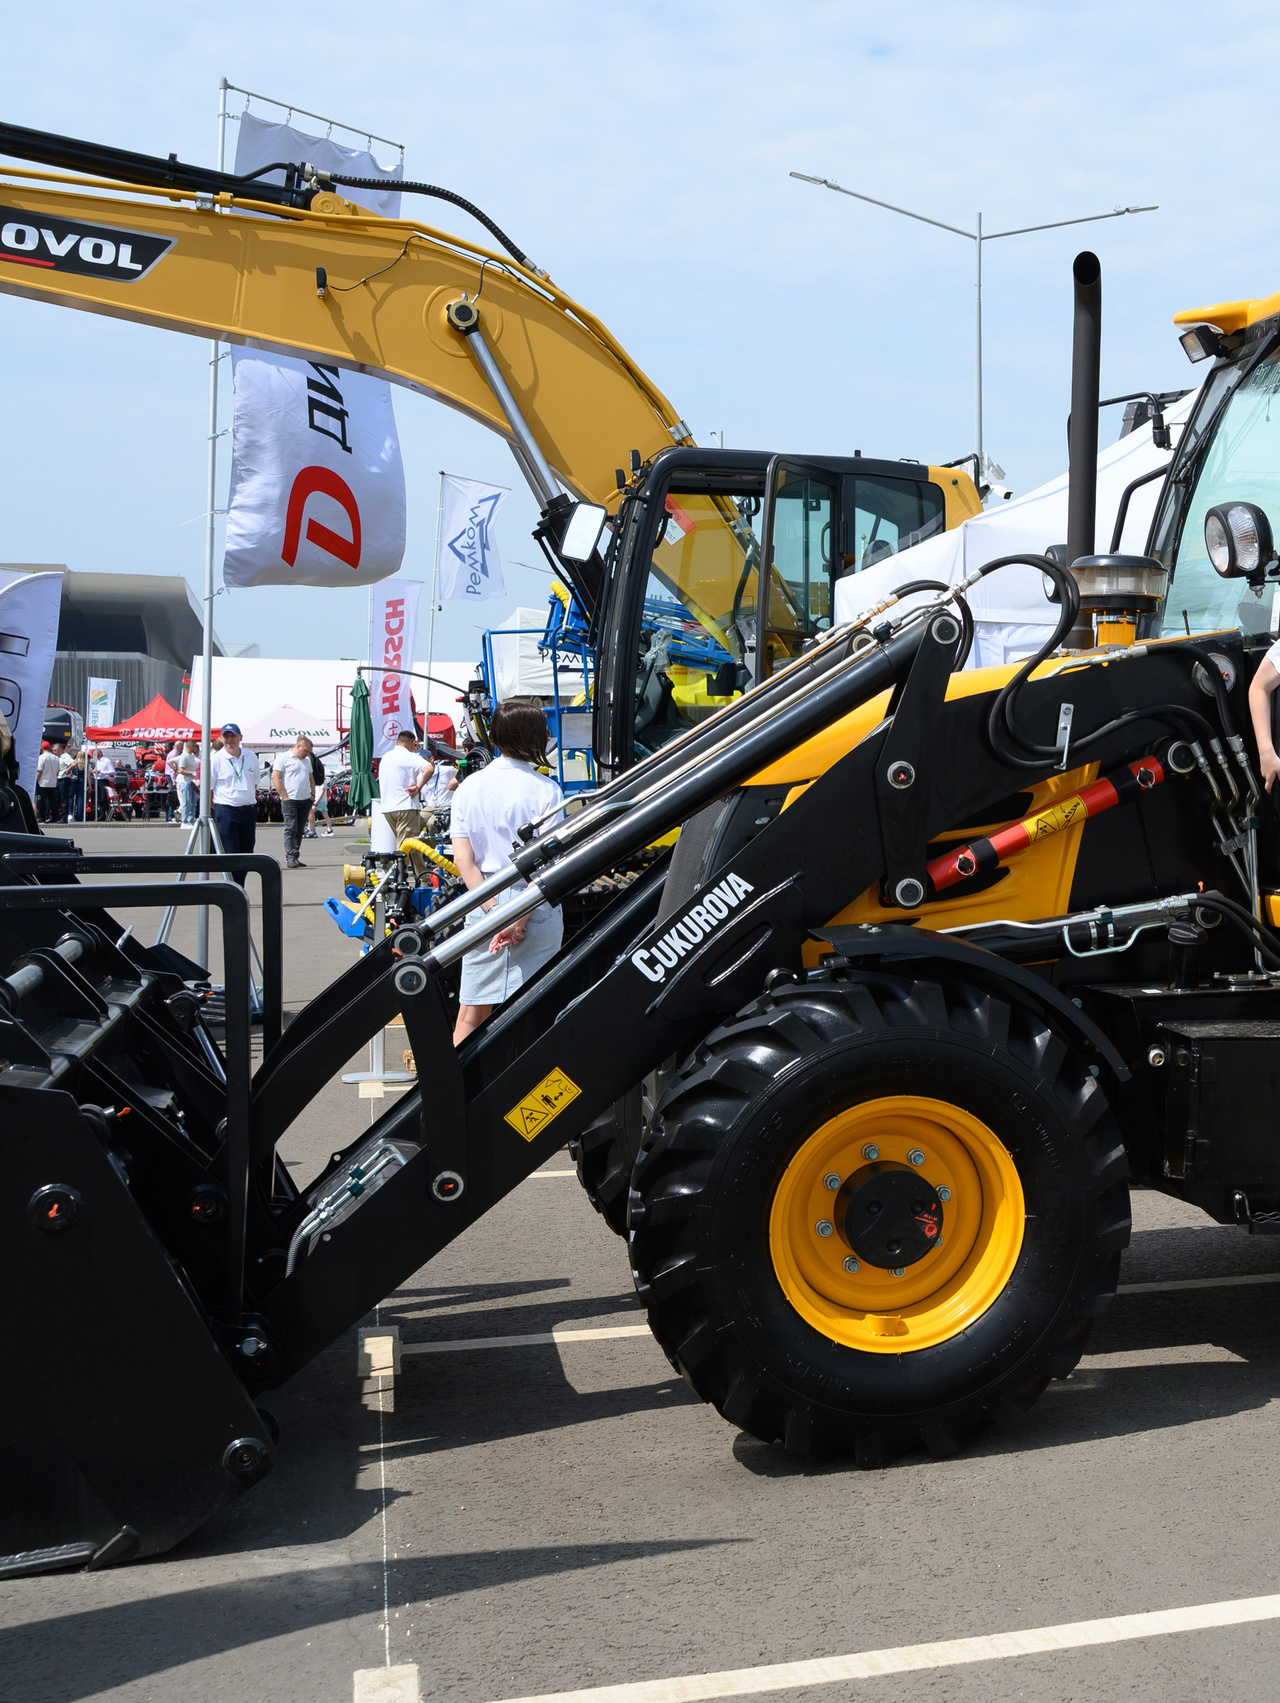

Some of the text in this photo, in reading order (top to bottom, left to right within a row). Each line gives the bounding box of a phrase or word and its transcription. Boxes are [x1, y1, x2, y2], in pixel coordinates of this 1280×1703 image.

[1, 222, 143, 271] OVOL
[132, 728, 195, 738] HORSCH
[631, 872, 755, 983] ÇUKUROVA
